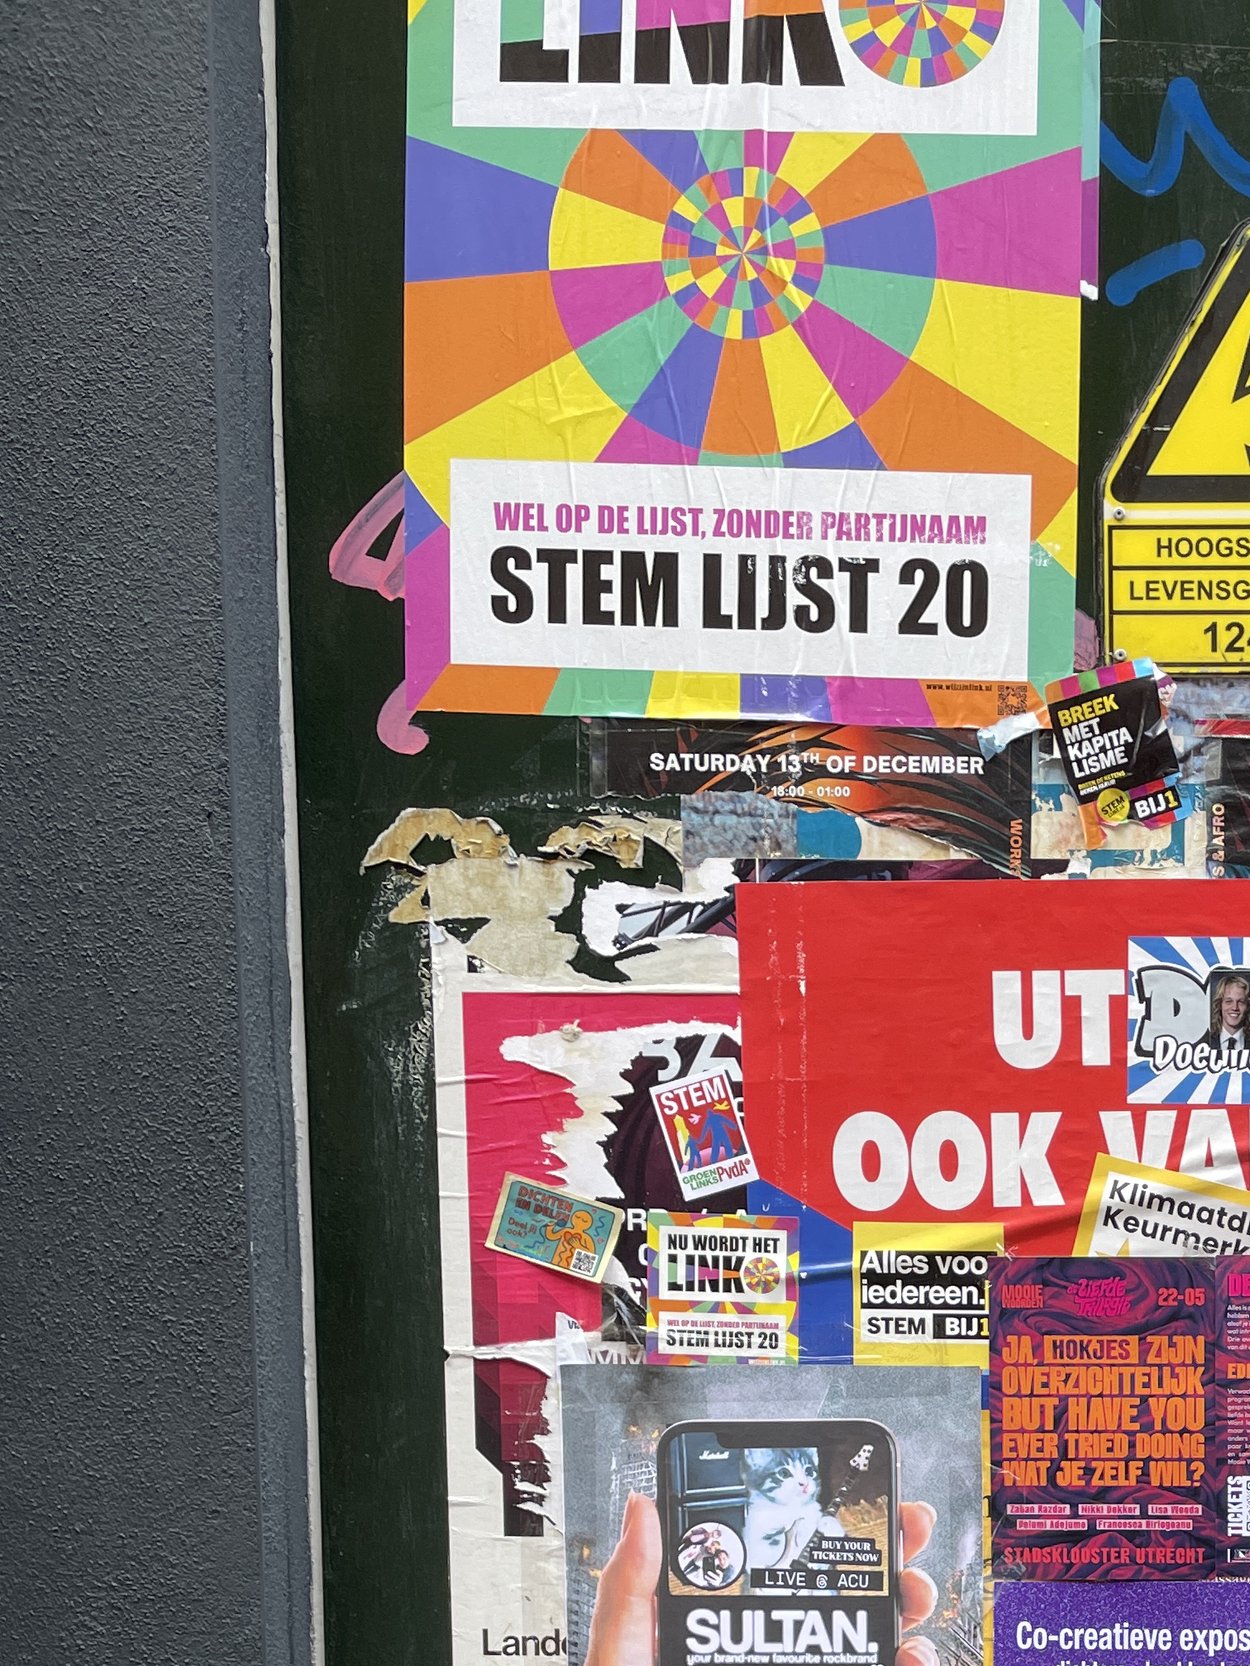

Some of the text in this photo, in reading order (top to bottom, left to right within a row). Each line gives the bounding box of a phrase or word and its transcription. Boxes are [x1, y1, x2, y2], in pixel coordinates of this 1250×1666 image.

[493, 502, 987, 545] WEL OP DE LIJST, ZONDER PARTIJNAAM
[489, 546, 989, 638] STEM LIJST 20
[1057, 694, 1119, 727] BREEK
[1062, 718, 1101, 744] MET
[1067, 727, 1134, 762] KAPITA
[650, 752, 984, 775] SATURDAY 13TH OF DECEMBER
[1072, 746, 1128, 778] LISME
[1134, 790, 1178, 819] BIJ1
[658, 1076, 726, 1116] STEM
[831, 1109, 1068, 1213] OOK
[667, 1233, 780, 1254] NU WORDT HET
[861, 1249, 929, 1275] Alles
[861, 1280, 985, 1304] iedereen.
[1157, 1288, 1205, 1306] 22-05
[1227, 1273, 1250, 1297] DE
[867, 1317, 989, 1335] STEM BIJ1
[666, 1329, 779, 1350] STEM LIJST 20
[1002, 1335, 1205, 1366] JA, HOKJES ZIJN
[1002, 1367, 1205, 1395] OVERZICHTELIJK
[1002, 1397, 1205, 1431] BUT HAVE YOU
[1003, 1433, 1205, 1459] EVER TRIED DOING
[1002, 1461, 1205, 1487] WAT JE ZELF WIL?
[1228, 1475, 1243, 1536] TICKETS
[812, 1551, 879, 1562] TICKETS NOW
[821, 1540, 871, 1550] BUY YOUR
[1003, 1548, 1206, 1564] STADSKLOOSTER UTRECHT
[764, 1571, 870, 1588] LIVE ACU
[686, 1608, 878, 1654] SULTAN.
[1016, 1620, 1173, 1653] Co-creatieve
